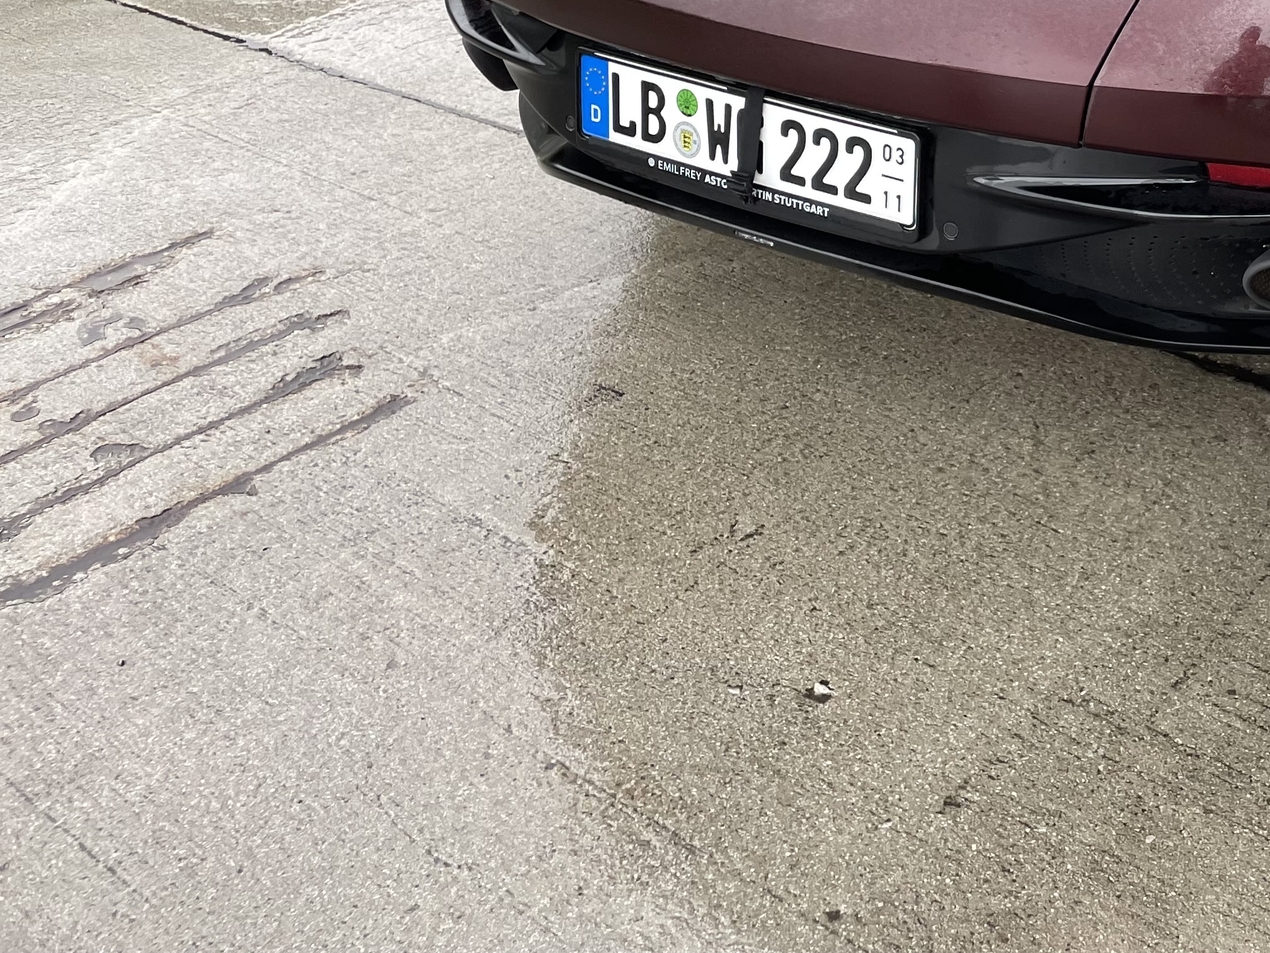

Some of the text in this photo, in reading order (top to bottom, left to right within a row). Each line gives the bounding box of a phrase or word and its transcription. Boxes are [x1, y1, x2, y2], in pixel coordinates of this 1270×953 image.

[590, 104, 601, 122] D
[612, 72, 666, 143] LB
[780, 119, 872, 204] 222
[883, 144, 904, 165] 03
[774, 195, 829, 217] STUTTGART
[883, 191, 902, 213] 11
